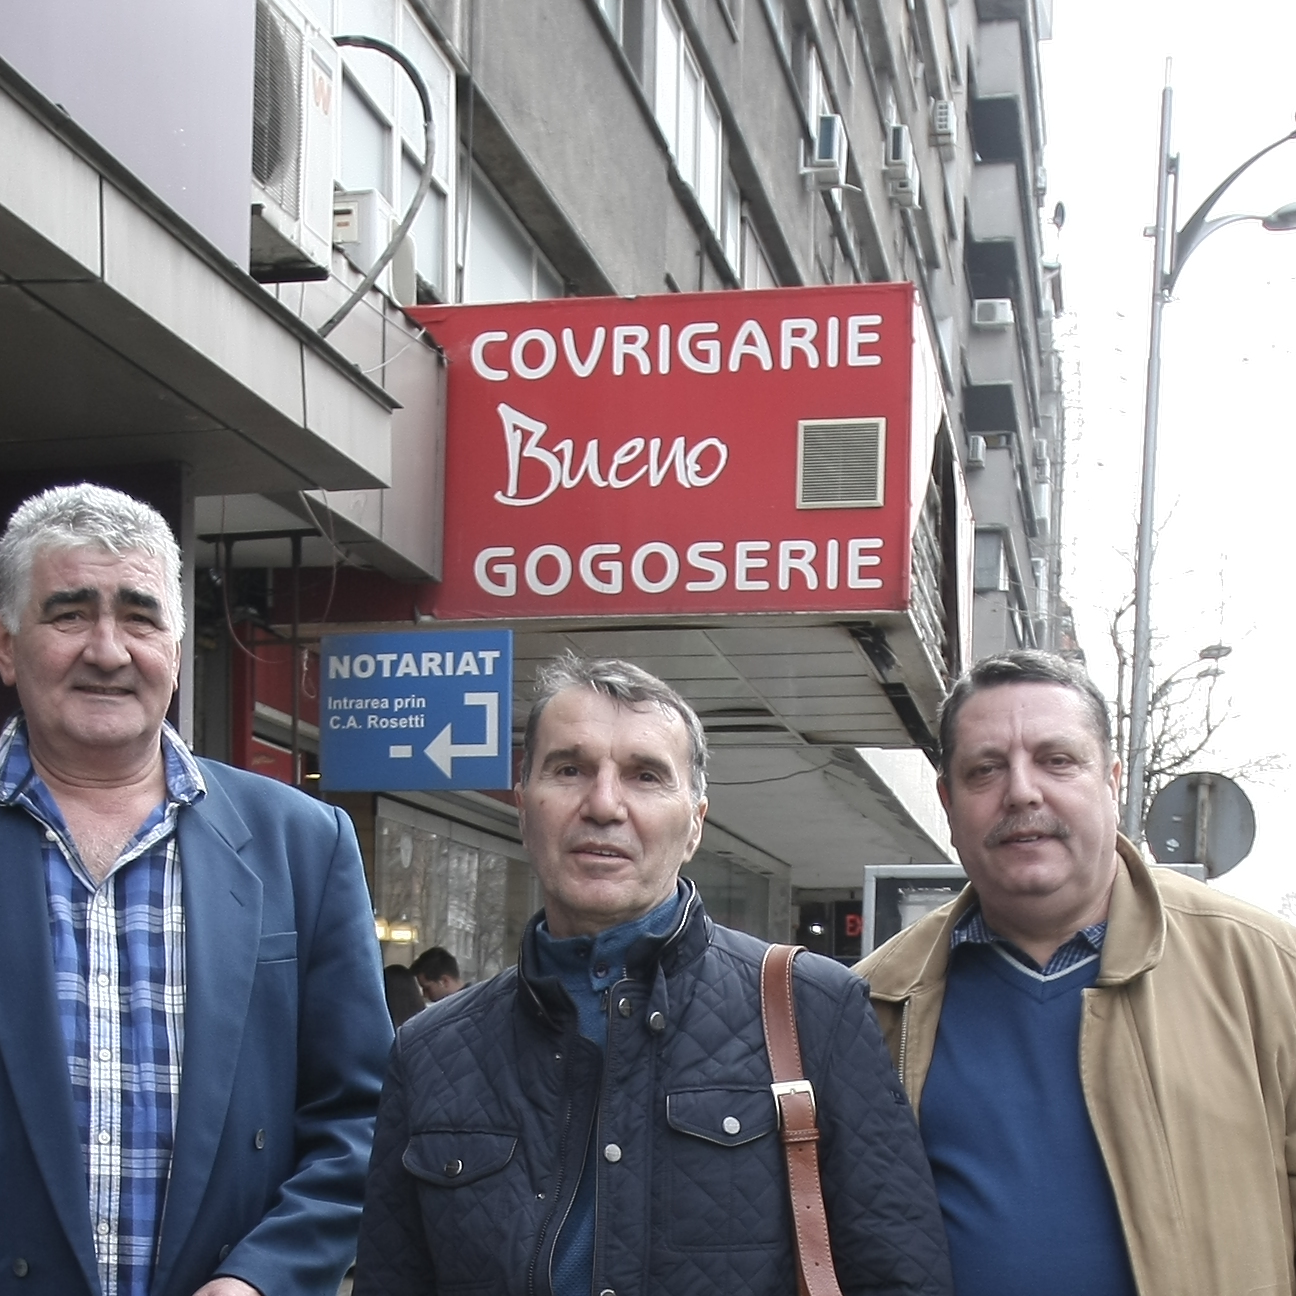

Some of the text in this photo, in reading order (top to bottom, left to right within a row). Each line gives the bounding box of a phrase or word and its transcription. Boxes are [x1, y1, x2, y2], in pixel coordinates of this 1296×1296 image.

[471, 313, 883, 382] COVRIGARIE
[494, 402, 729, 507] Bueno
[474, 537, 884, 597] GOGOSERIE
[328, 651, 500, 680] NOTARIAT
[328, 695, 426, 712] Intrarea prin
[329, 714, 425, 730] C.A. Rosetti
